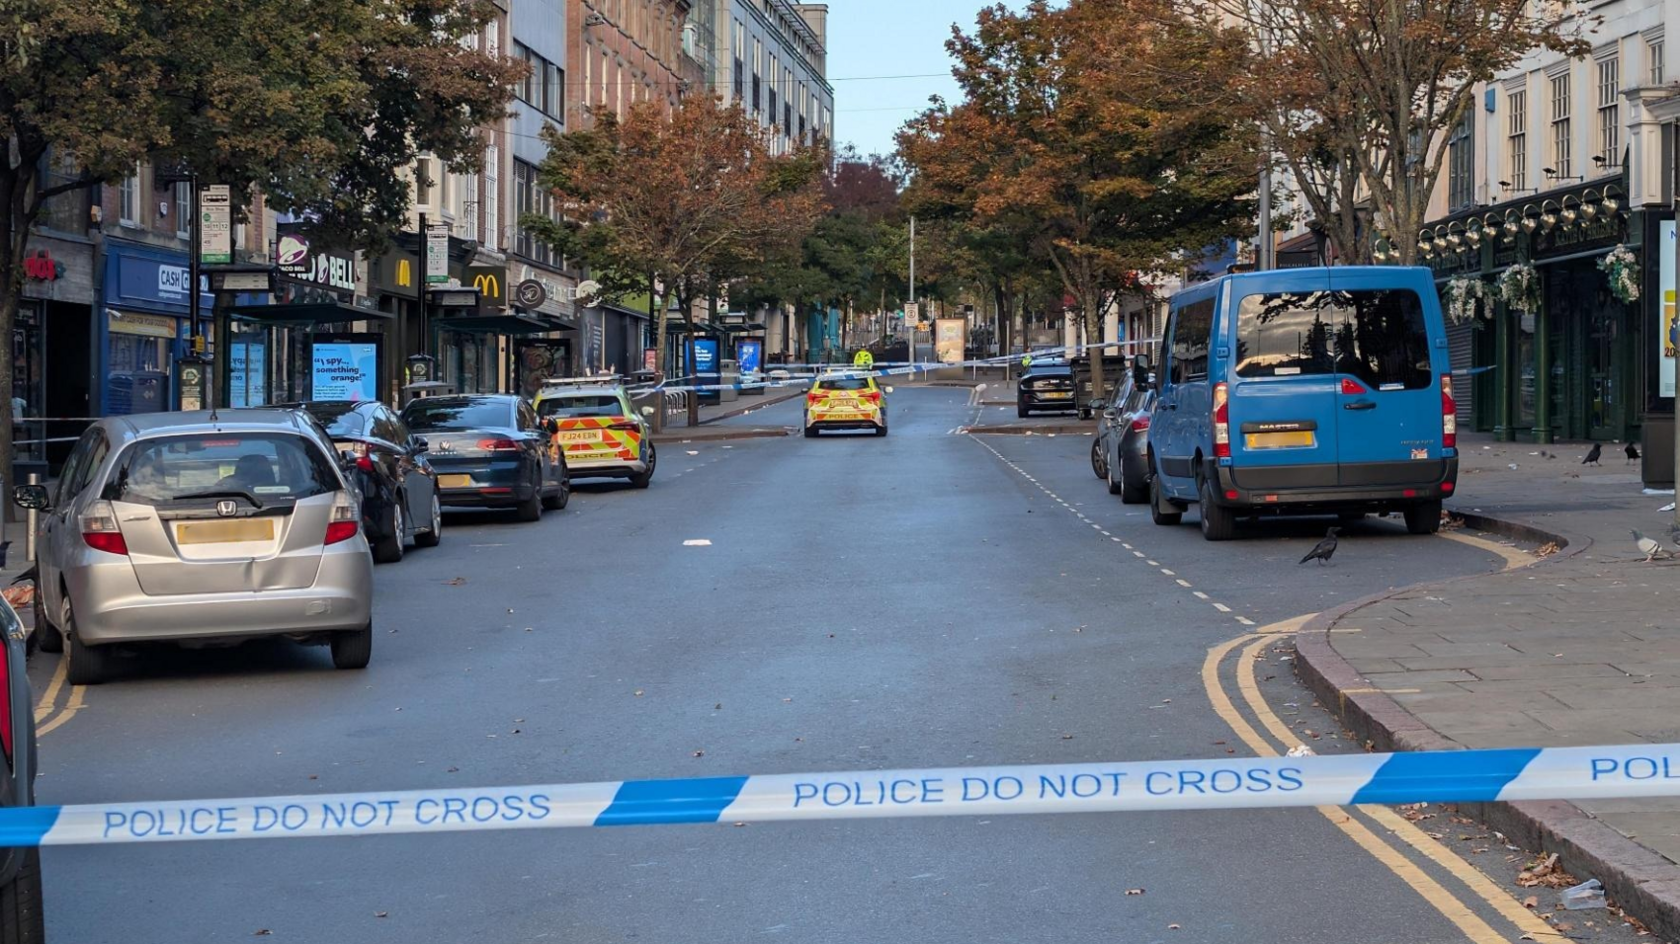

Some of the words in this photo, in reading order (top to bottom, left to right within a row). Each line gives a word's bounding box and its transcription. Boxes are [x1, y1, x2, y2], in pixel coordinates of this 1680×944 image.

[160, 270, 180, 287] CASH
[329, 256, 355, 290] BELL
[316, 366, 359, 374] something
[1591, 757, 1680, 781] POL
[793, 778, 944, 808] POLICE
[961, 776, 1023, 801] DO
[1038, 771, 1128, 800] NOT
[1145, 767, 1304, 796] CROSS
[102, 806, 238, 839] POLICE
[252, 804, 309, 832] DO
[321, 800, 400, 829] NOT
[414, 793, 551, 826] CROSS
